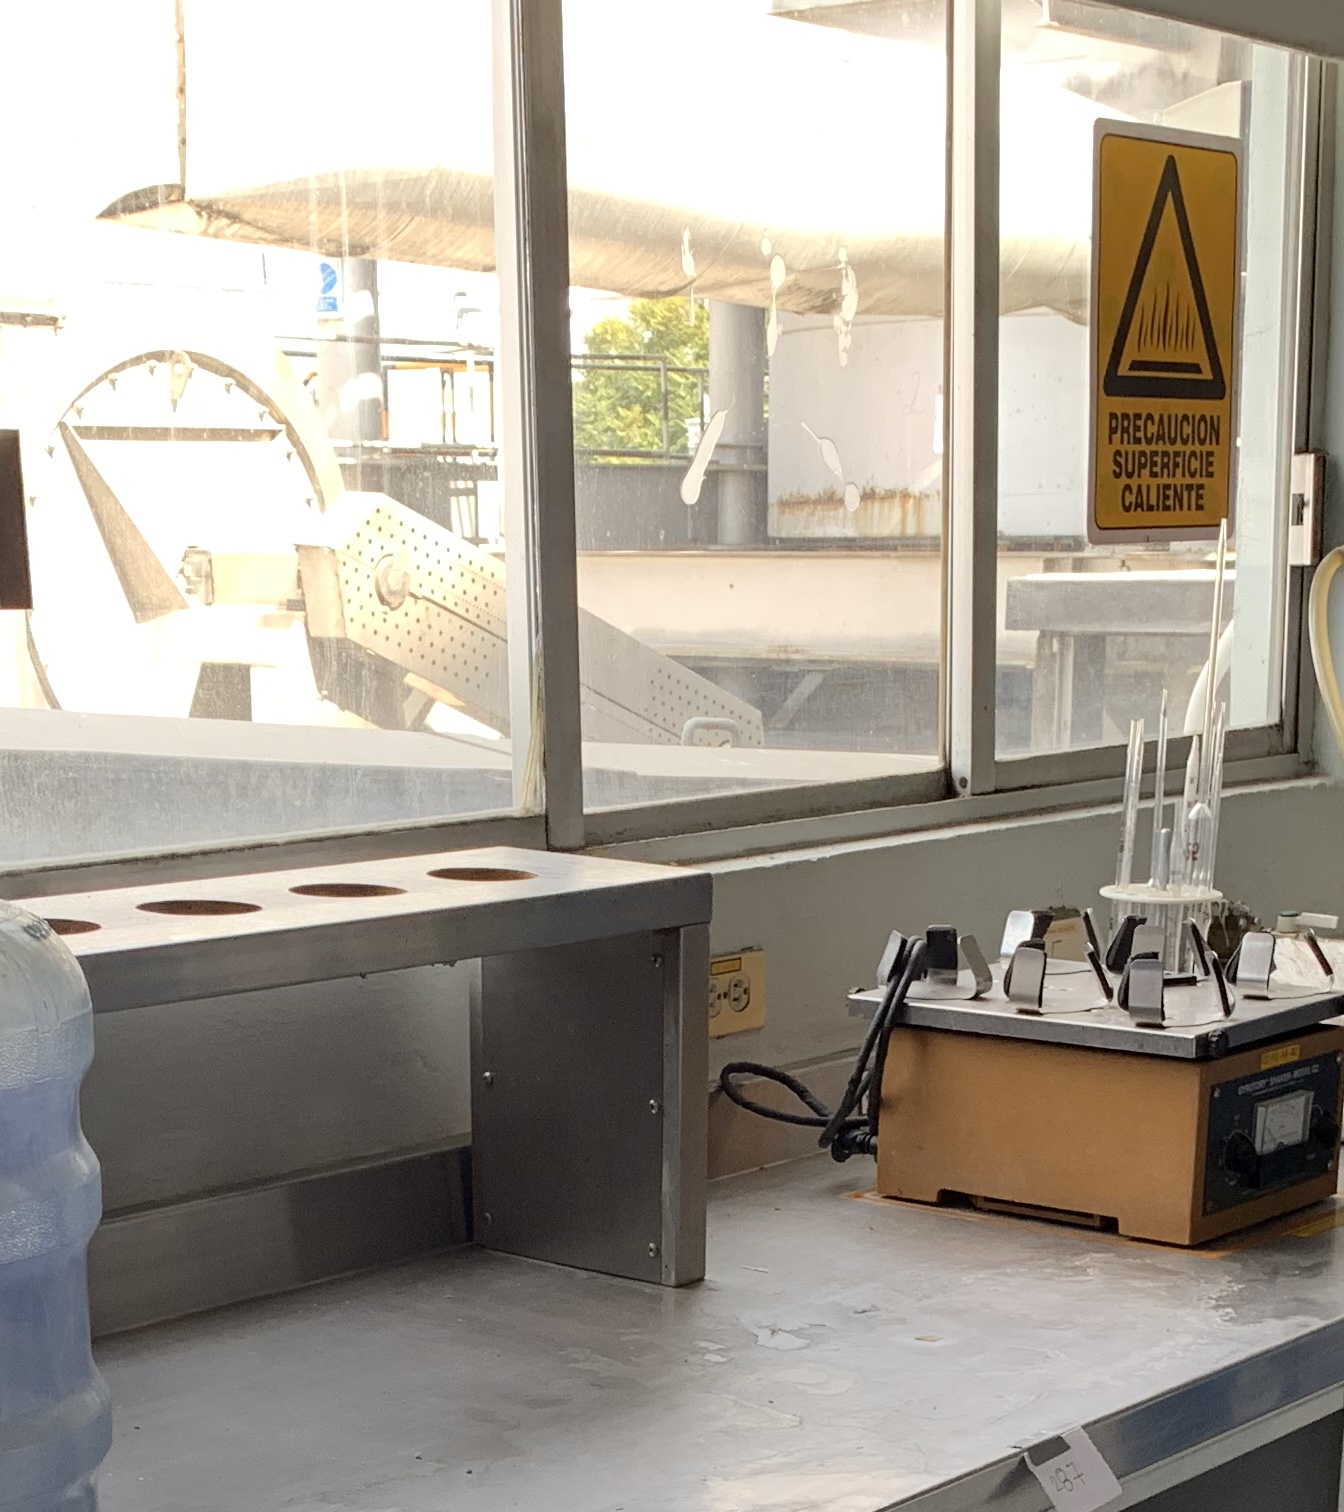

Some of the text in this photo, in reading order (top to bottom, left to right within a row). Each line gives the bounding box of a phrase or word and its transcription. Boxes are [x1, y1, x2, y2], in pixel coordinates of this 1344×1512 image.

[1108, 411, 1221, 448] PRECAUCION
[1112, 449, 1215, 480] SUPERFICIE
[1121, 483, 1205, 514] CALIENTE
[1049, 1461, 1087, 1492] 287
